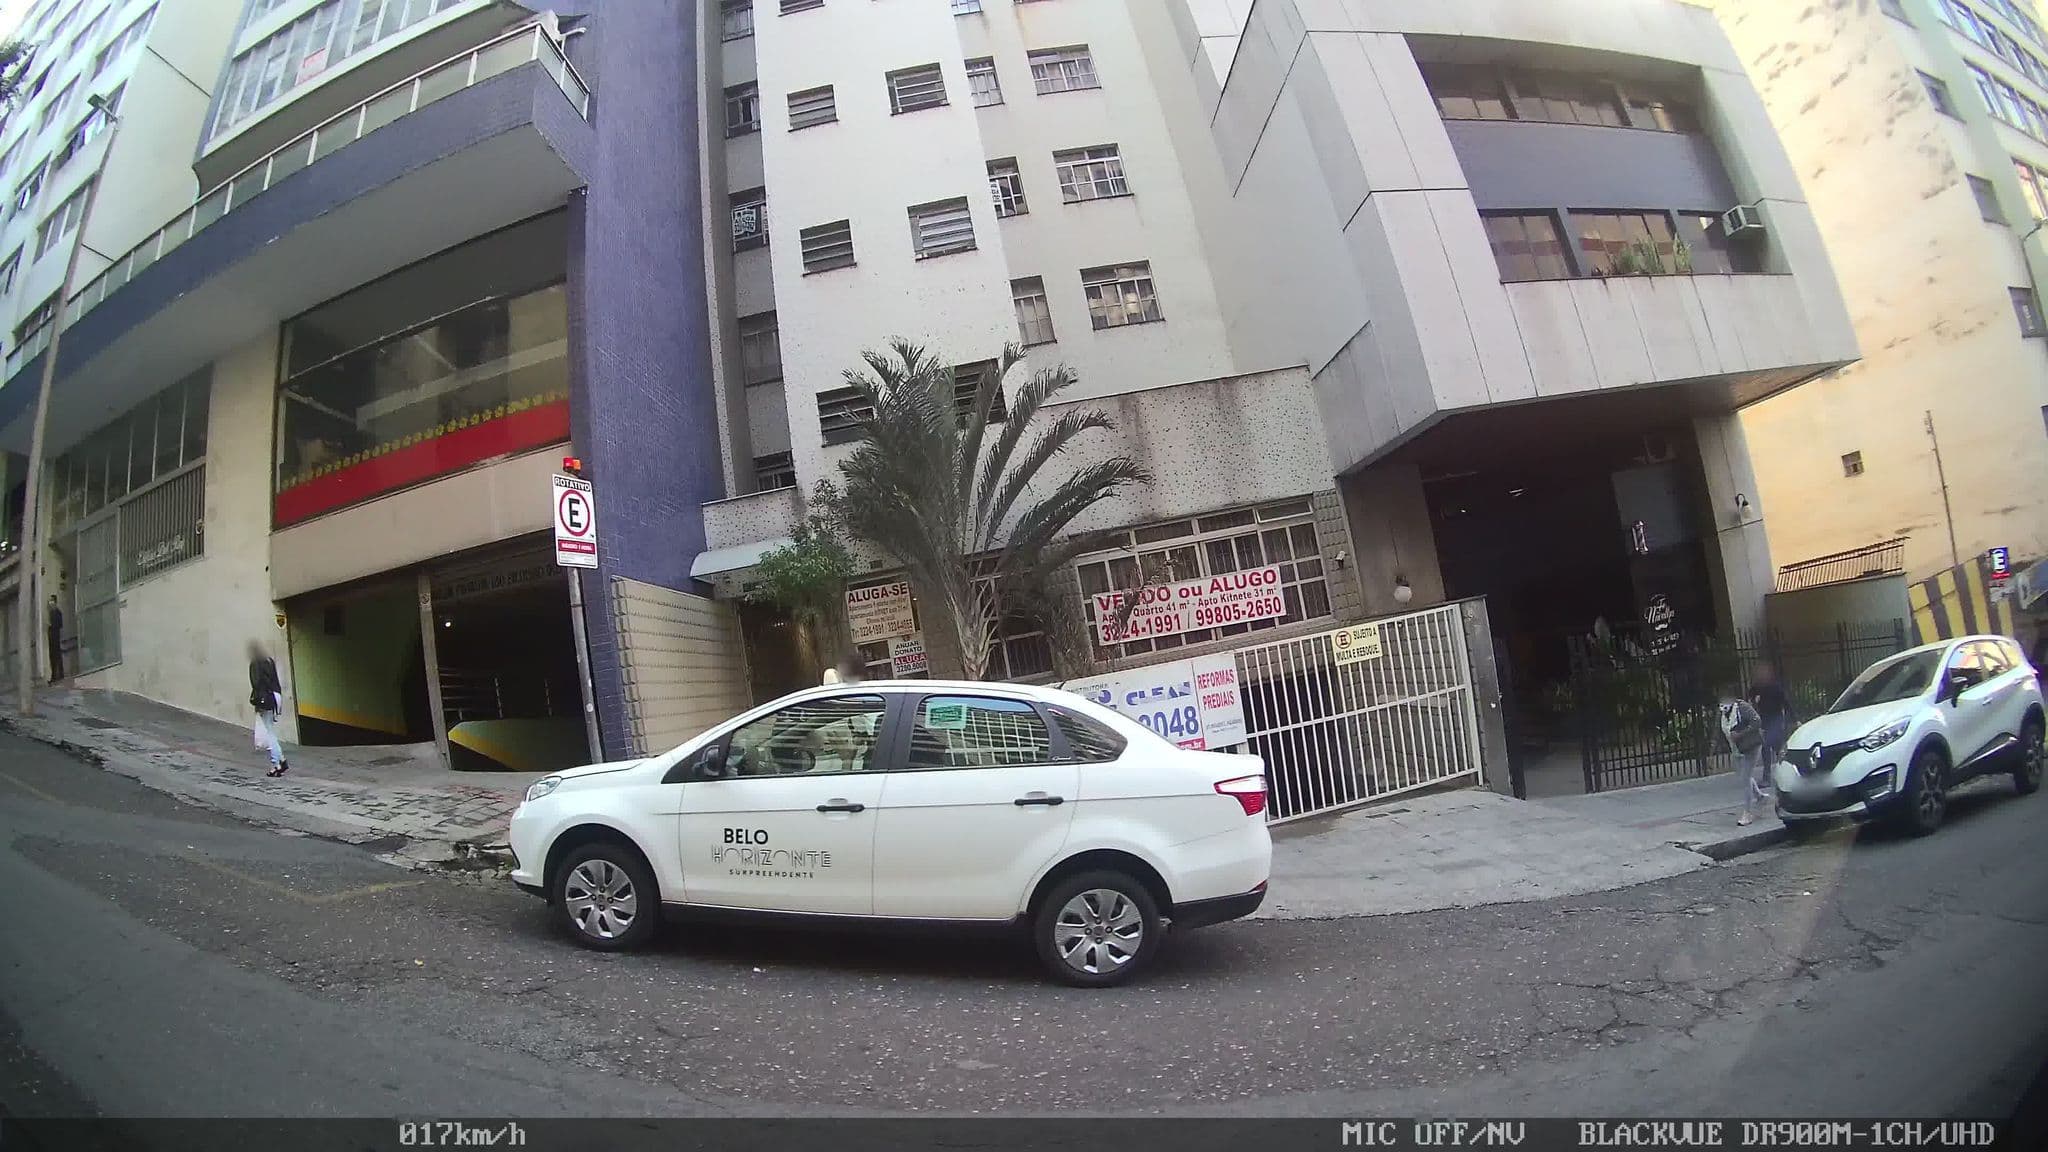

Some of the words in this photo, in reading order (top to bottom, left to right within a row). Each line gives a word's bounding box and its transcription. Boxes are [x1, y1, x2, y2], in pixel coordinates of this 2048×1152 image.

[554, 477, 591, 492] ROTATIVO
[568, 498, 582, 528] E
[848, 583, 908, 603] ALUGA-SE
[1098, 586, 1171, 611] VEDO
[1179, 586, 1203, 598] ou
[1210, 569, 1277, 594] ALUGO
[1133, 605, 1164, 617] Quarto
[1166, 602, 1176, 611] 41
[1198, 598, 1218, 608] Apto
[1220, 591, 1252, 603] Kitnete
[1254, 588, 1264, 597] 31
[1196, 596, 1282, 626] 99805-2650
[1352, 627, 1373, 640] SUJEITO
[895, 646, 922, 656] DONATO
[895, 654, 927, 665] ALUGA
[1336, 649, 1352, 661] MULTA
[1356, 644, 1380, 658] REBOQUE
[1197, 668, 1234, 690] REFORMAS
[1203, 690, 1235, 711] PREDIAIS
[723, 828, 769, 845] BELO
[711, 845, 832, 868] HORIZONTE
[729, 868, 815, 879] SURPREENDENTE
